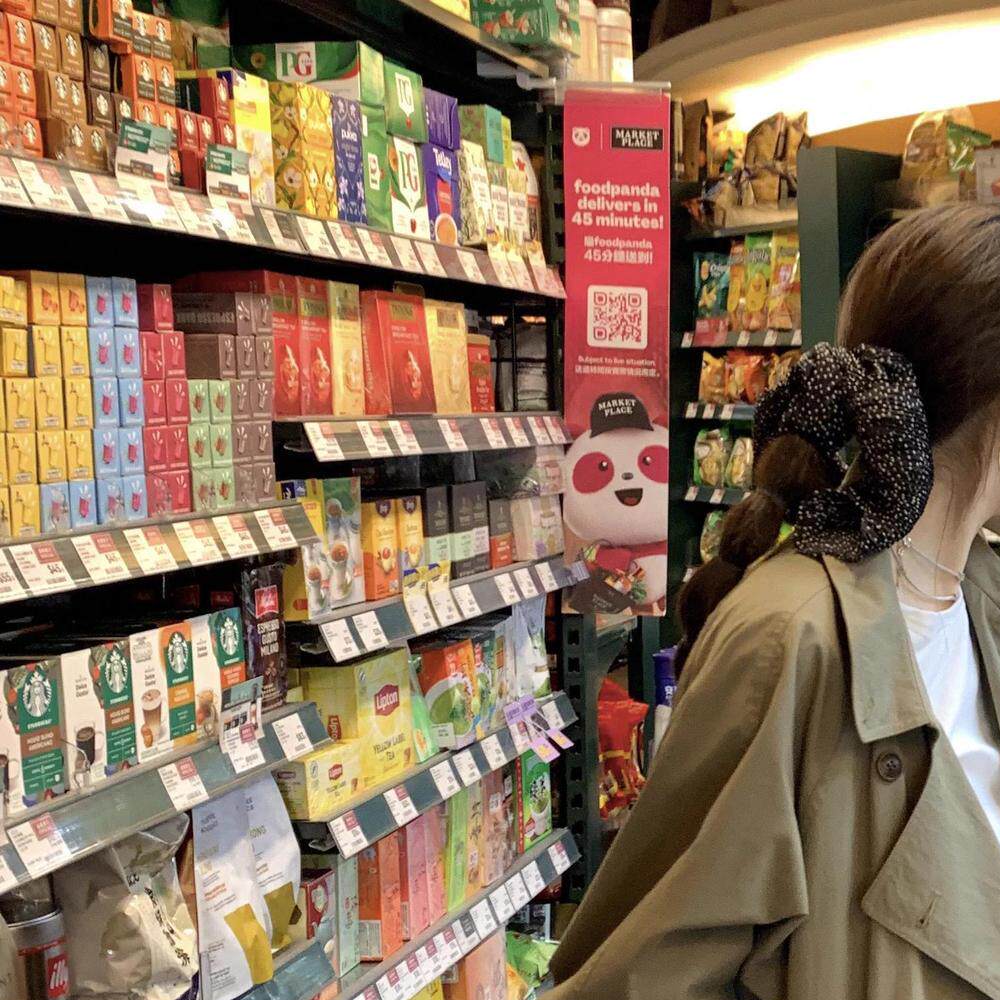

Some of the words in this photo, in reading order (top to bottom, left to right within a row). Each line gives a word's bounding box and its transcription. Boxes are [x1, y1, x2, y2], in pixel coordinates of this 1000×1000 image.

[615, 129, 660, 141] MARKET
[621, 137, 653, 148] PLACE
[574, 178, 661, 198] foodpanda
[577, 195, 641, 213] delivers
[643, 197, 658, 213] in
[571, 211, 593, 226] 45
[595, 214, 664, 230] minutes!
[598, 398, 636, 411] MARKET
[604, 406, 633, 418] PLACE
[374, 691, 399, 712] Lipton
[329, 717, 339, 741] Lipto
[373, 739, 391, 756] YELLOW
[391, 732, 406, 746] LABEL
[386, 750, 395, 761] TEA
